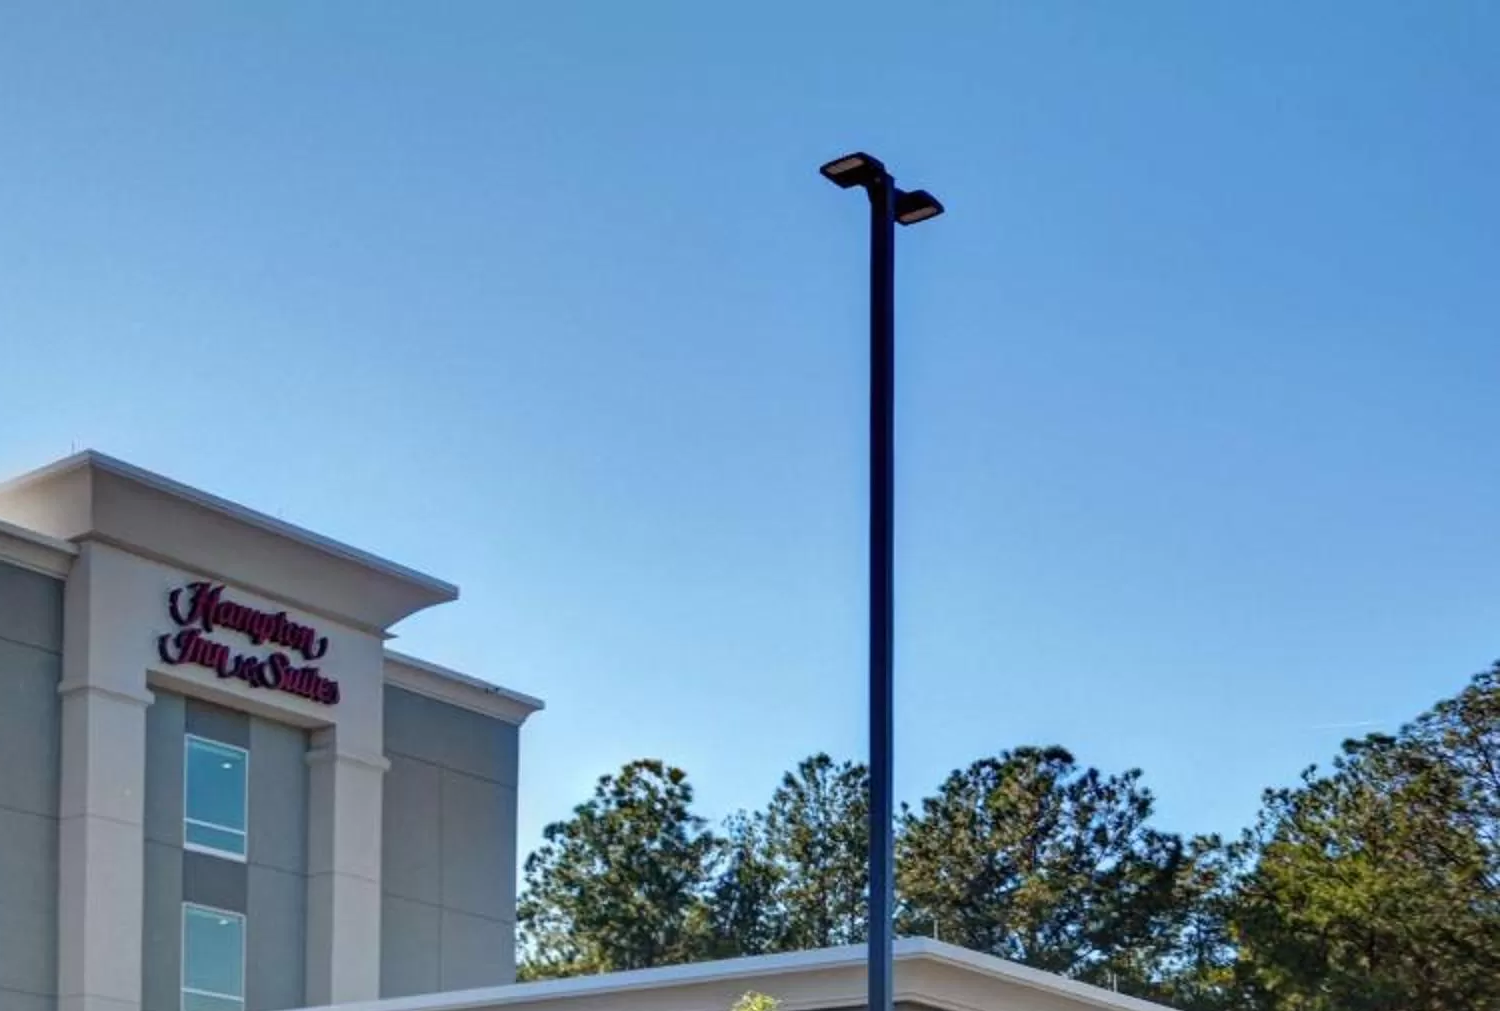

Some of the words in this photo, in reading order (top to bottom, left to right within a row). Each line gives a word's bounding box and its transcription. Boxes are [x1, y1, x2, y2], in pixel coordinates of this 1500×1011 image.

[168, 581, 328, 660] Hampton
[158, 629, 243, 678] Inn
[255, 652, 340, 704] Suites
